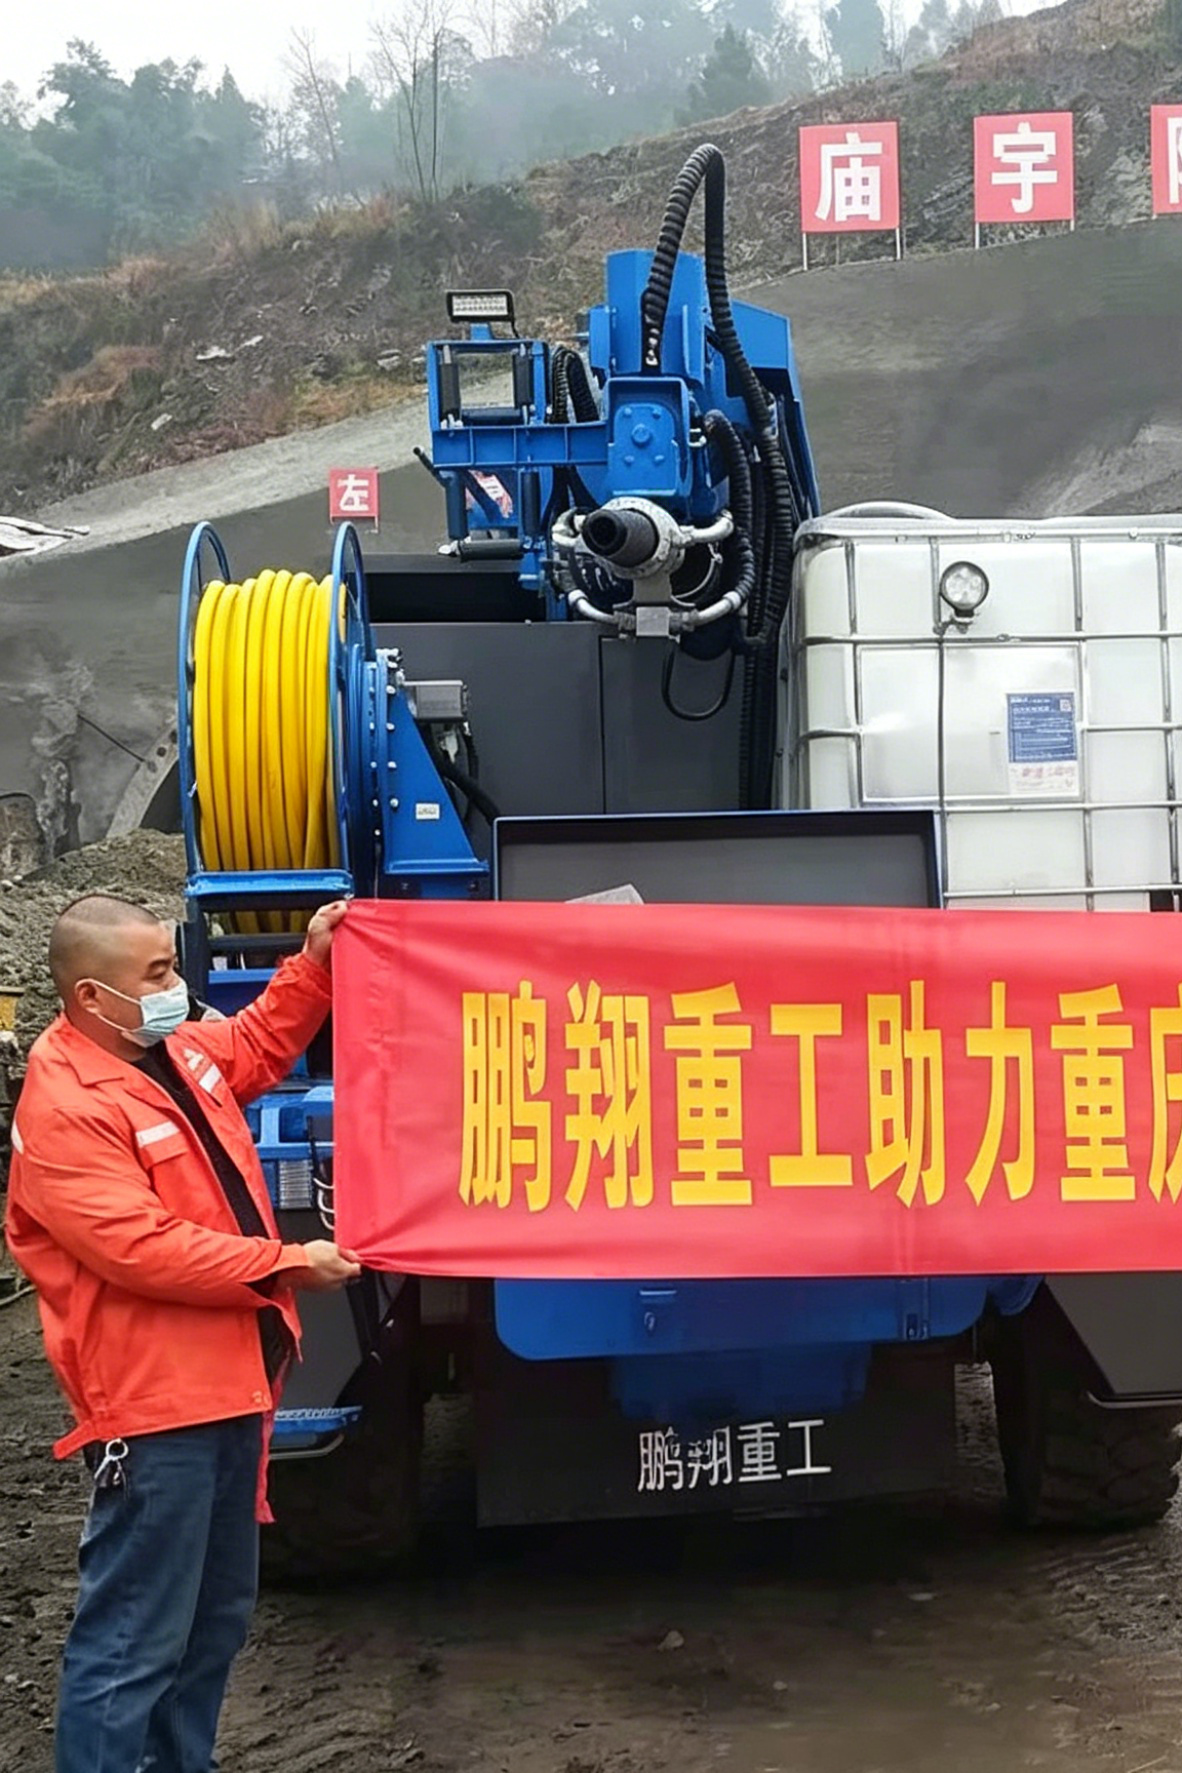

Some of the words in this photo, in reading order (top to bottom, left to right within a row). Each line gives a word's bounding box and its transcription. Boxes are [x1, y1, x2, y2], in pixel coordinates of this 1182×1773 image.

[337, 473, 370, 512] 左
[637, 1418, 832, 1493] 鹏翔重工
